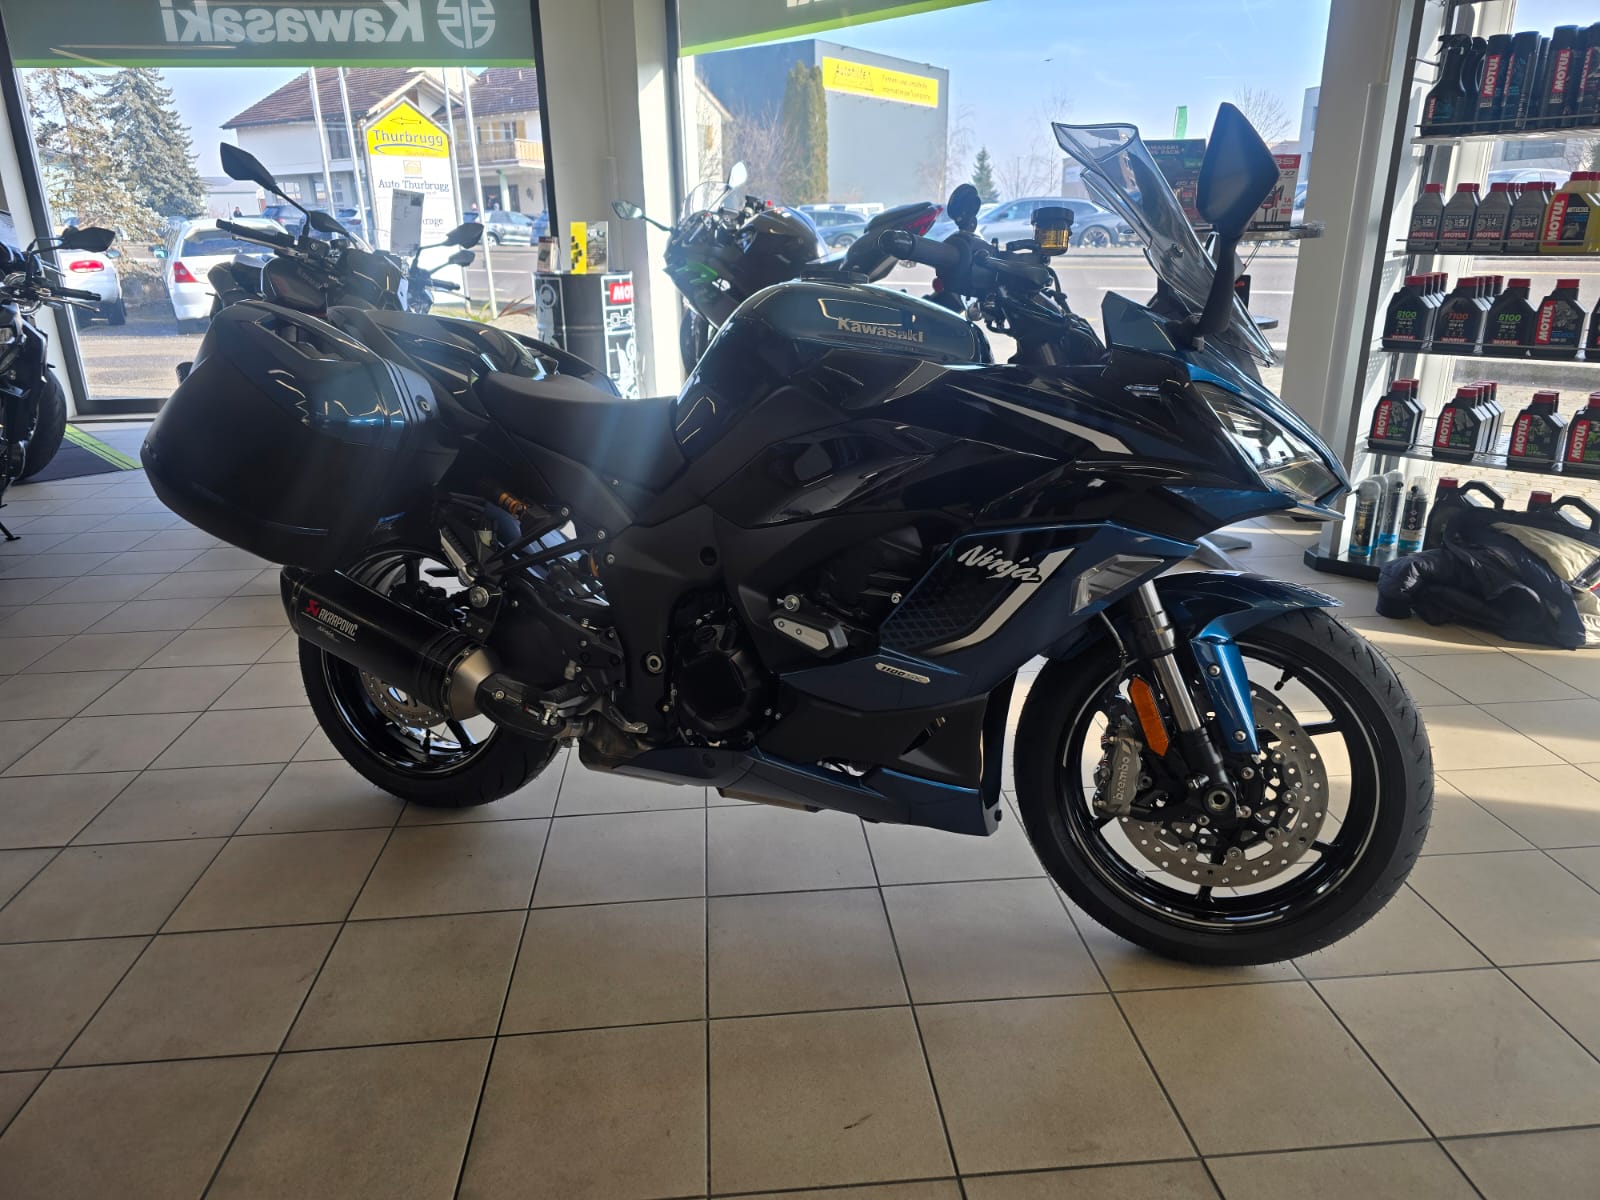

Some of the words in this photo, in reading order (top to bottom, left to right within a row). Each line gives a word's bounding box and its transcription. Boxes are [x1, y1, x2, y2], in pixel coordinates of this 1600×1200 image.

[1483, 56, 1499, 95] MOTUL
[372, 129, 443, 147] Thurbrugg
[378, 179, 401, 189] Auto
[402, 179, 450, 193] Thurbrugg
[422, 217, 444, 228] rage
[1475, 231, 1500, 239] MOTUL
[1546, 199, 1565, 241] MOTUL
[837, 316, 924, 343] Kawasaki
[1538, 304, 1554, 341] MOTUL
[1376, 404, 1389, 436] MOTUL
[1439, 411, 1453, 445] MOTUL
[1514, 418, 1529, 453] MOTUL
[1571, 424, 1587, 459] MOTUL
[957, 544, 1041, 582] Ninja
[881, 666, 906, 677] 1100
[1113, 756, 1130, 801] brembo
